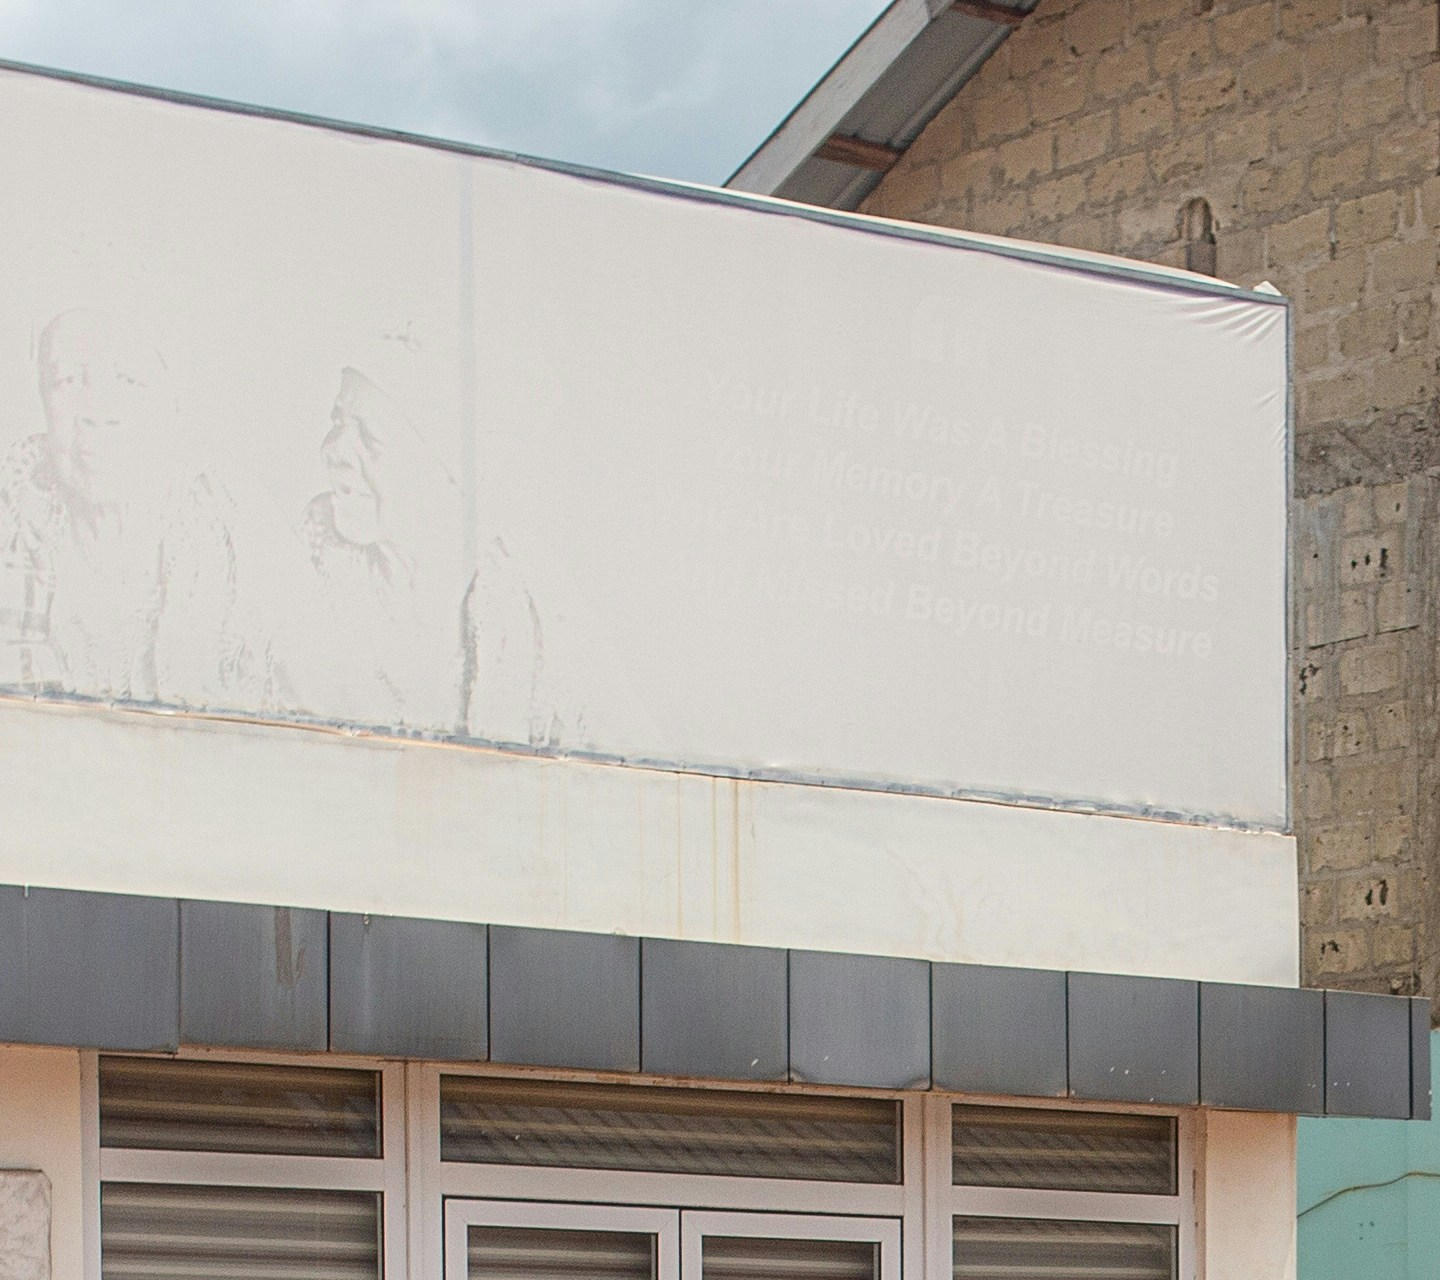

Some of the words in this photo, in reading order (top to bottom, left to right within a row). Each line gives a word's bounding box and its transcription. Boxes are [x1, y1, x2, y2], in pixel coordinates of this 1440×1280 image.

[705, 371, 797, 419] Your
[807, 385, 880, 432] Life
[891, 399, 972, 448] Was
[981, 417, 1008, 455] A
[1020, 423, 1180, 490] Blessing
[711, 431, 800, 481] Your
[812, 448, 966, 516] Memory
[975, 475, 1003, 512] A
[1017, 479, 1176, 539] Treasure
[823, 511, 943, 564] Loved
[952, 529, 1097, 585] Beyond
[1106, 553, 1221, 604] Words
[906, 583, 1051, 639] Beyond
[1059, 604, 1215, 660] Measure
